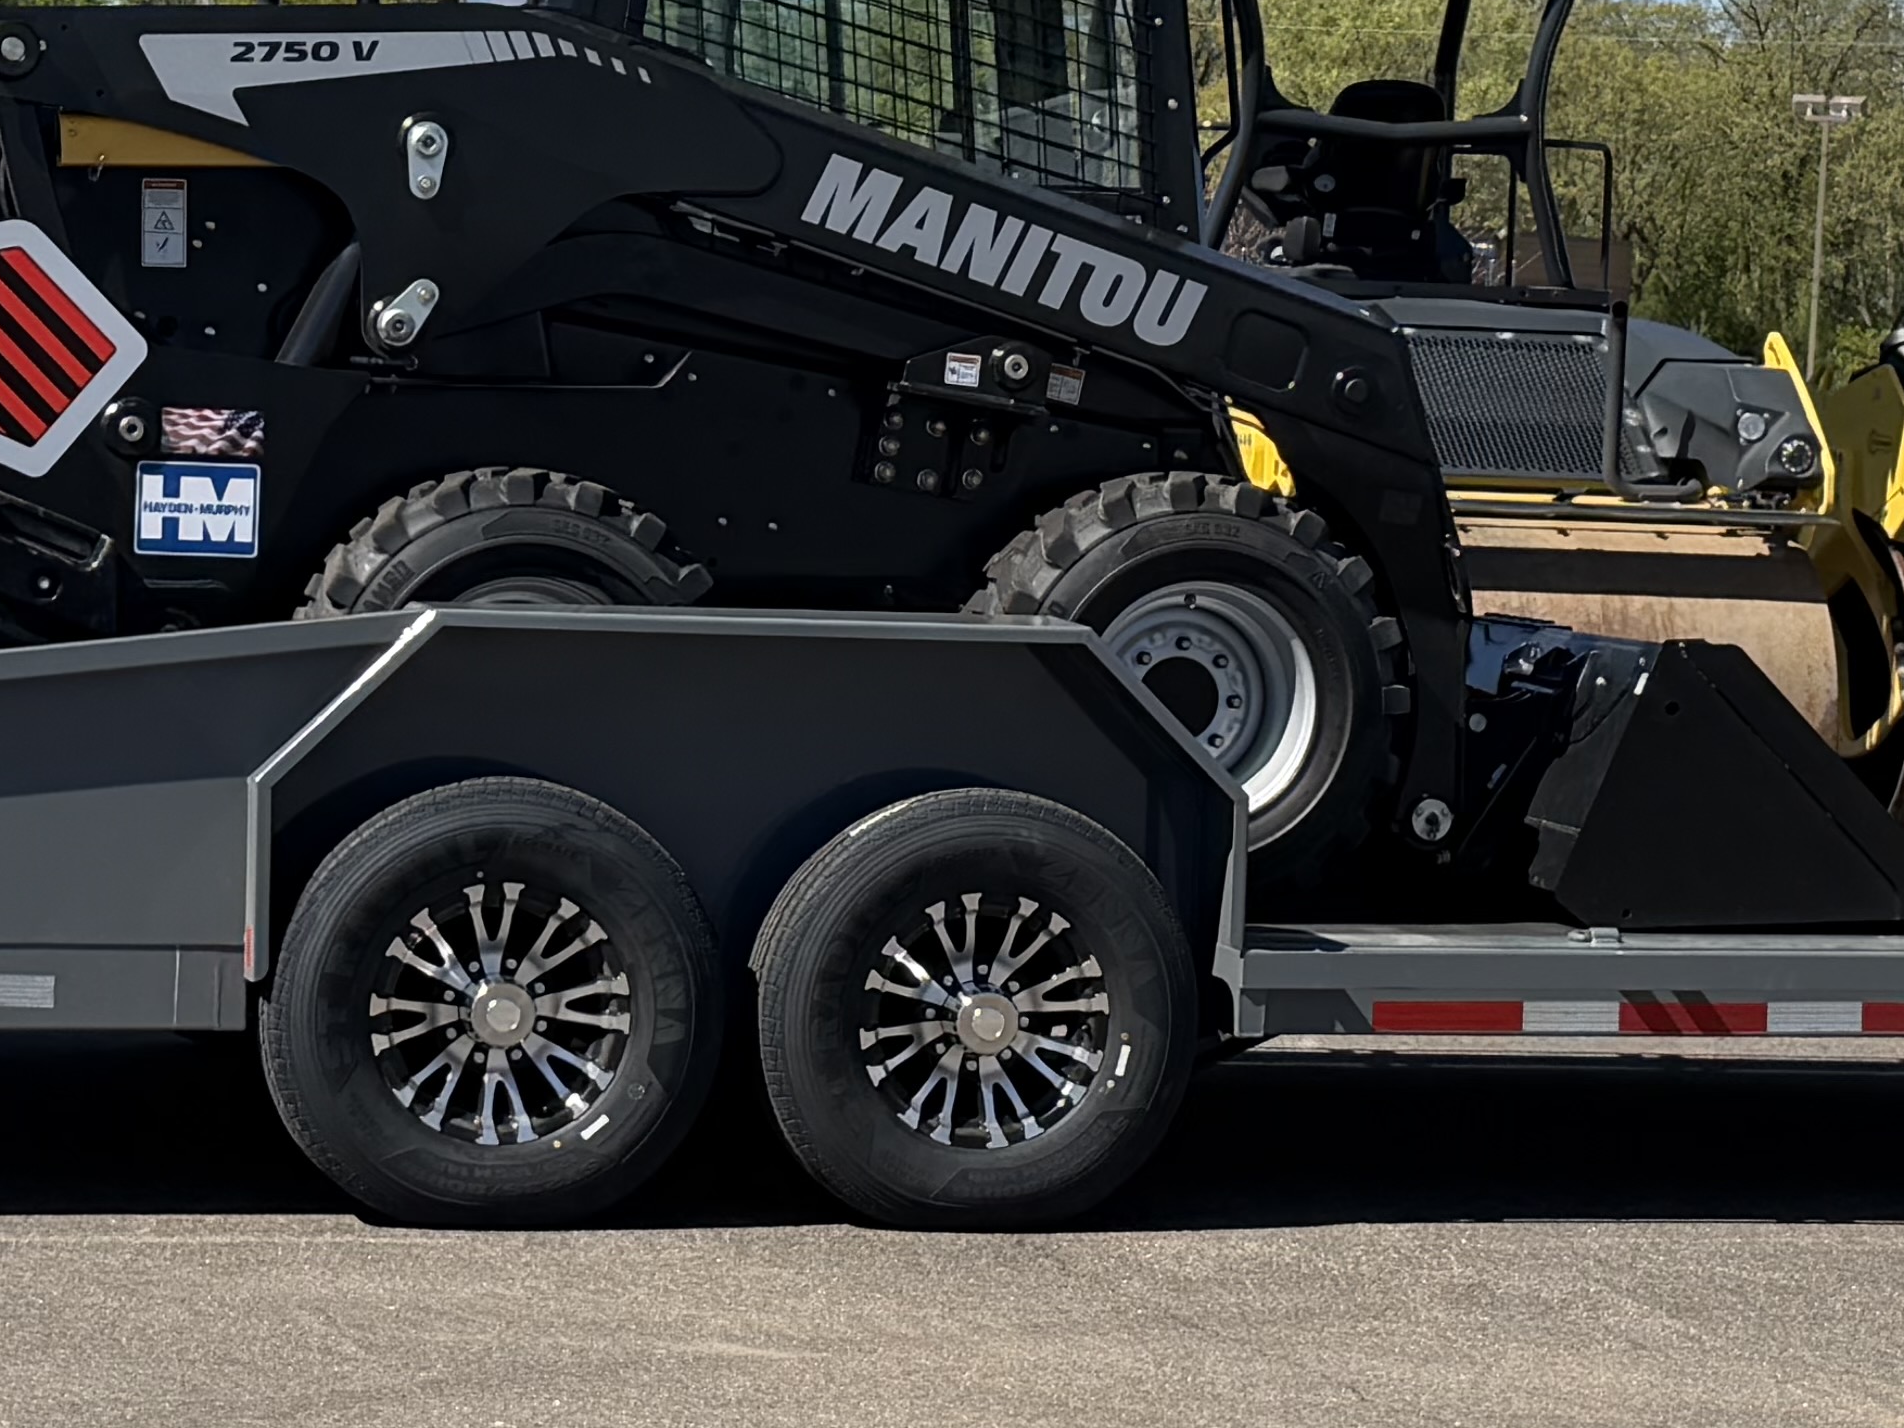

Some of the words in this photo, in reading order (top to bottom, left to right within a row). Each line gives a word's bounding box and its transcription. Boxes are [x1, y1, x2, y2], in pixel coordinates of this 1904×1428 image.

[230, 41, 340, 62] 2750
[352, 40, 380, 62] V
[799, 152, 1208, 347] MANITOU
[140, 474, 254, 542] HM
